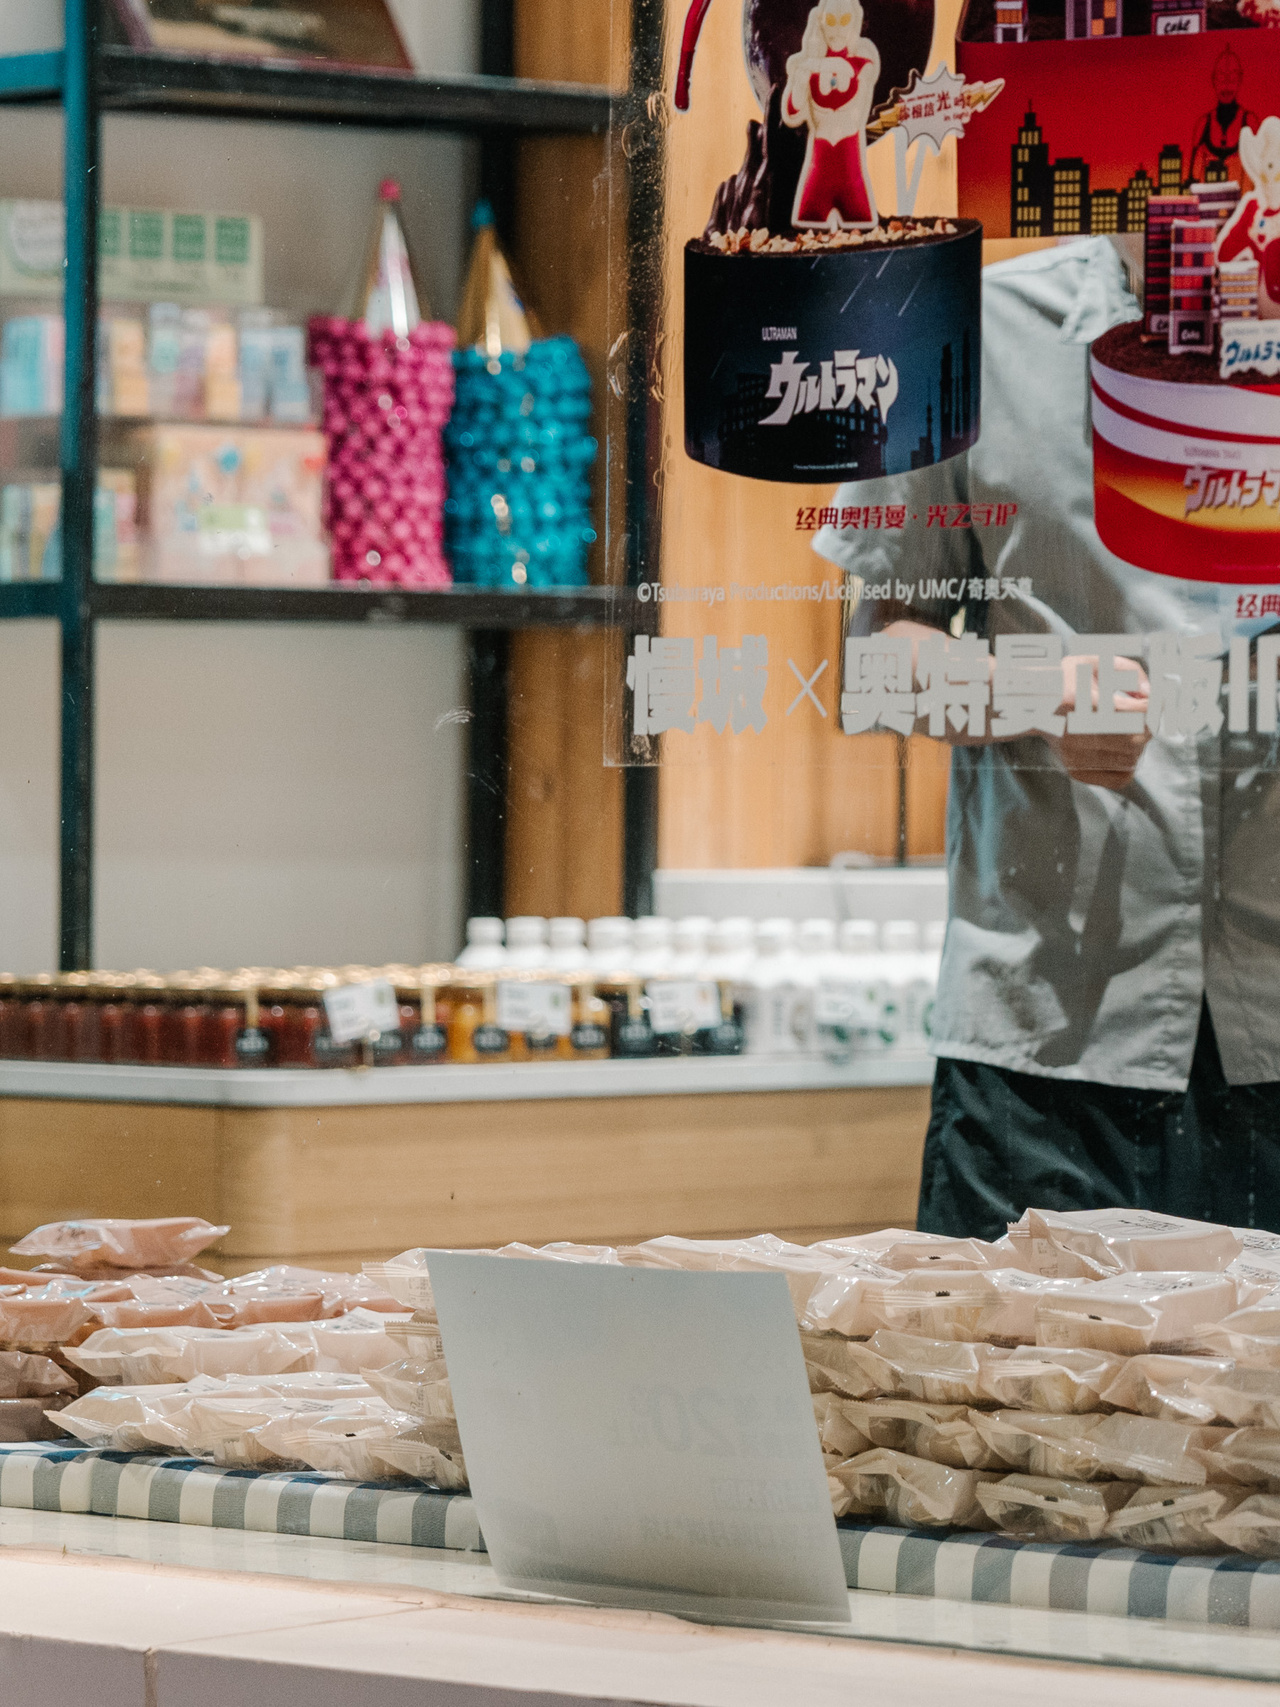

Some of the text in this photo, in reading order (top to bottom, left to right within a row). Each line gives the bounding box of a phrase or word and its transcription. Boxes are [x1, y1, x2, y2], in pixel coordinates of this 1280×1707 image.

[761, 326, 798, 341] ULTRAMAN
[757, 349, 899, 425] ウルトラマン
[895, 579, 915, 605] by
